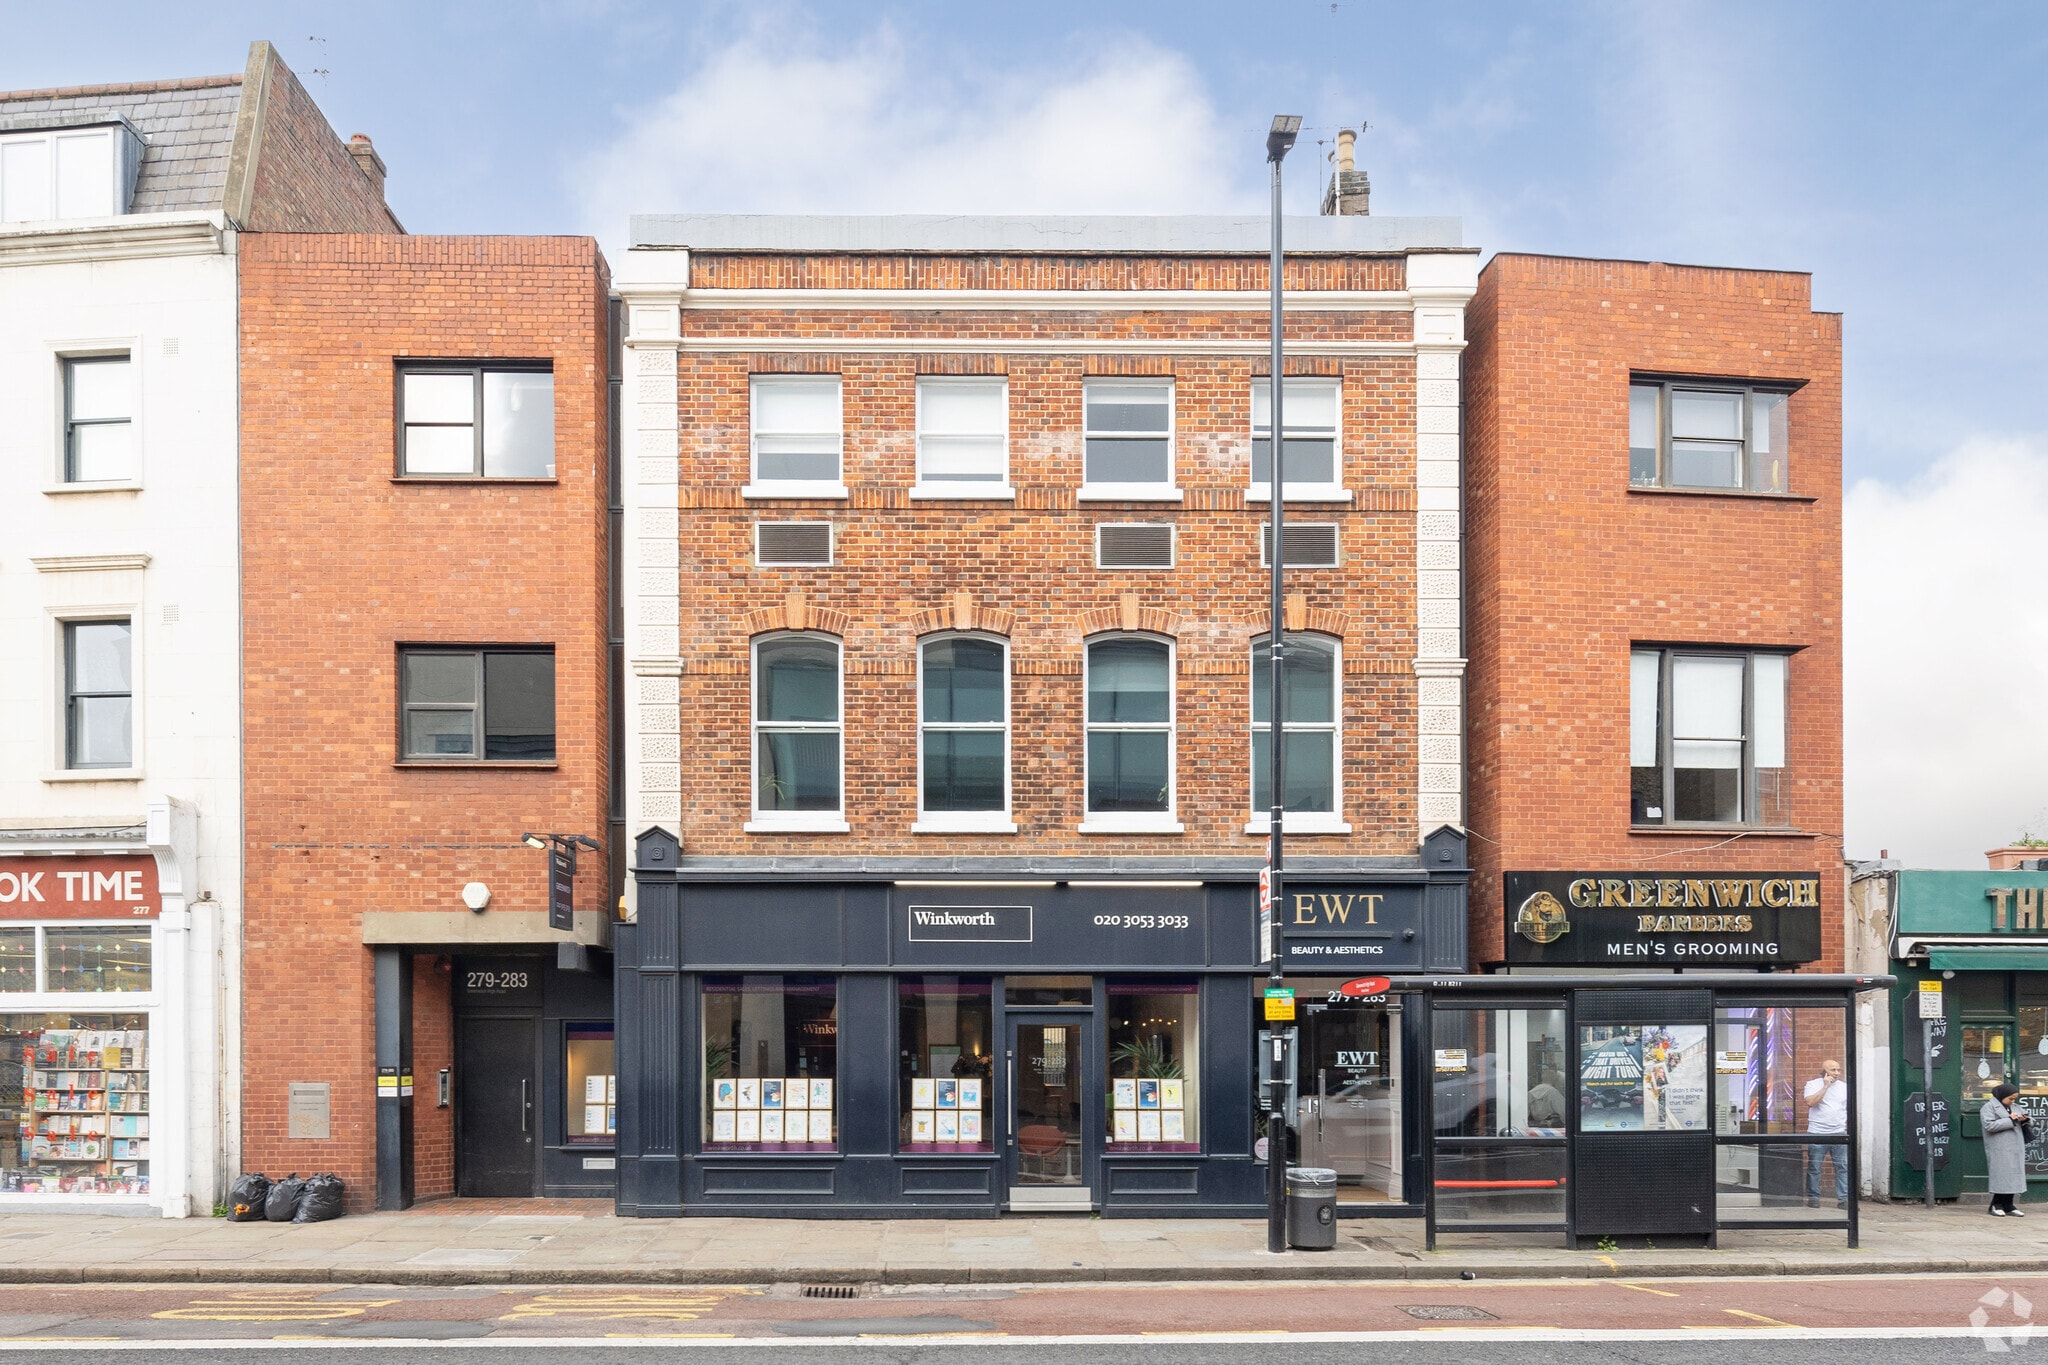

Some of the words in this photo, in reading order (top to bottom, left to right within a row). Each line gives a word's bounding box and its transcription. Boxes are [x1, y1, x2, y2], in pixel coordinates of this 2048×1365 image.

[57, 871, 143, 901] TIME
[1568, 878, 1819, 908] GREENWICH
[133, 906, 150, 915] 277
[1292, 894, 1384, 925] EWT
[1985, 888, 2048, 929] TH
[914, 911, 995, 926] Winkworth
[1093, 915, 1121, 925] 020
[1123, 915, 1155, 928] 3053
[1158, 915, 1189, 928] 3033
[1637, 914, 1753, 933] BARBERS
[1291, 946, 1324, 955] BEAUTY
[1325, 946, 1333, 954] &
[1333, 946, 1383, 954] AESTHETICS
[1607, 941, 1666, 956] MEN'S
[1674, 942, 1779, 955] GROOMING
[467, 972, 528, 988] 279-283
[23, 1044, 98, 1063] Sale
[1336, 1051, 1379, 1065] EWT
[1591, 1057, 1610, 1066] THAT
[1609, 1057, 1634, 1066] DRIVER
[1580, 1066, 1613, 1079] MIGHT
[1614, 1065, 1642, 1078] TURN
[23, 1084, 99, 1103] Sale
[1914, 1101, 1948, 1112] ORER
[2019, 1097, 2048, 1108] STA
[23, 1124, 99, 1142] Sale
[1916, 1122, 1949, 1136] PNE
